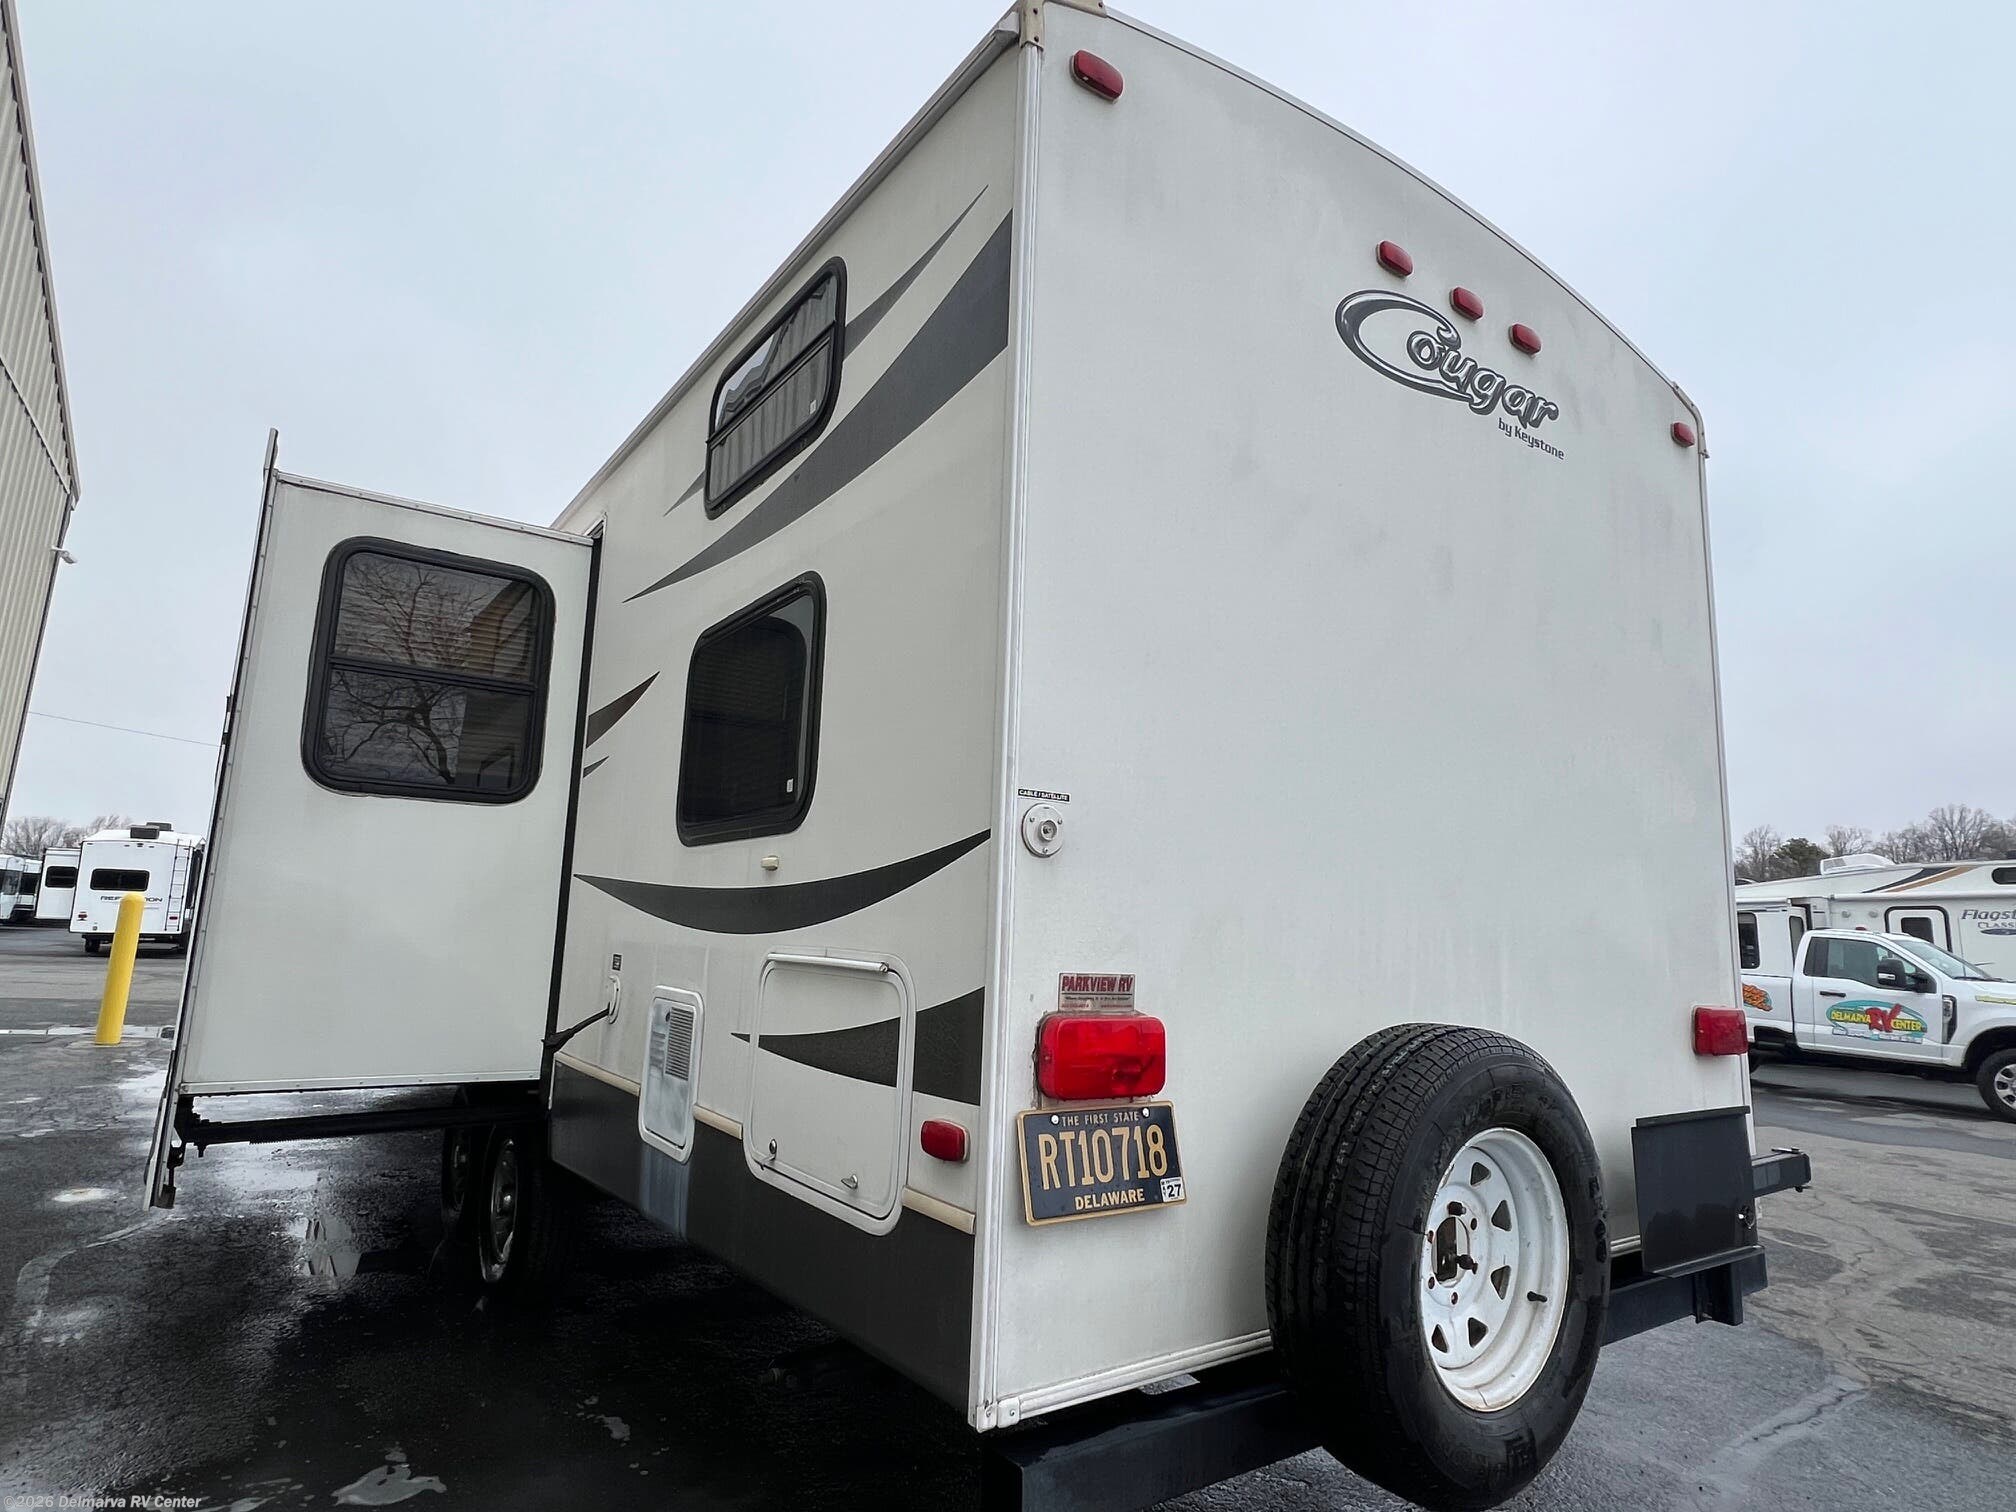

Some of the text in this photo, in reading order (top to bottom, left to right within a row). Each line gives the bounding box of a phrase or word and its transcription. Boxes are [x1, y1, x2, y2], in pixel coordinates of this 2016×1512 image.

[1335, 289, 1559, 430] Cougar
[1498, 417, 1565, 460] by Keystone
[1019, 789, 1038, 797] CABLE
[1041, 792, 1068, 801] SATELLITE
[1061, 975, 1133, 992] PARKVIEW RV
[1831, 1003, 1922, 1033] DELMARVA RV CENTER
[1061, 1111, 1139, 1126] THE FIRST STATE
[1038, 1124, 1168, 1191] RT10718
[1074, 1188, 1145, 1211] DELAWARE
[1167, 1184, 1181, 1198] 27
